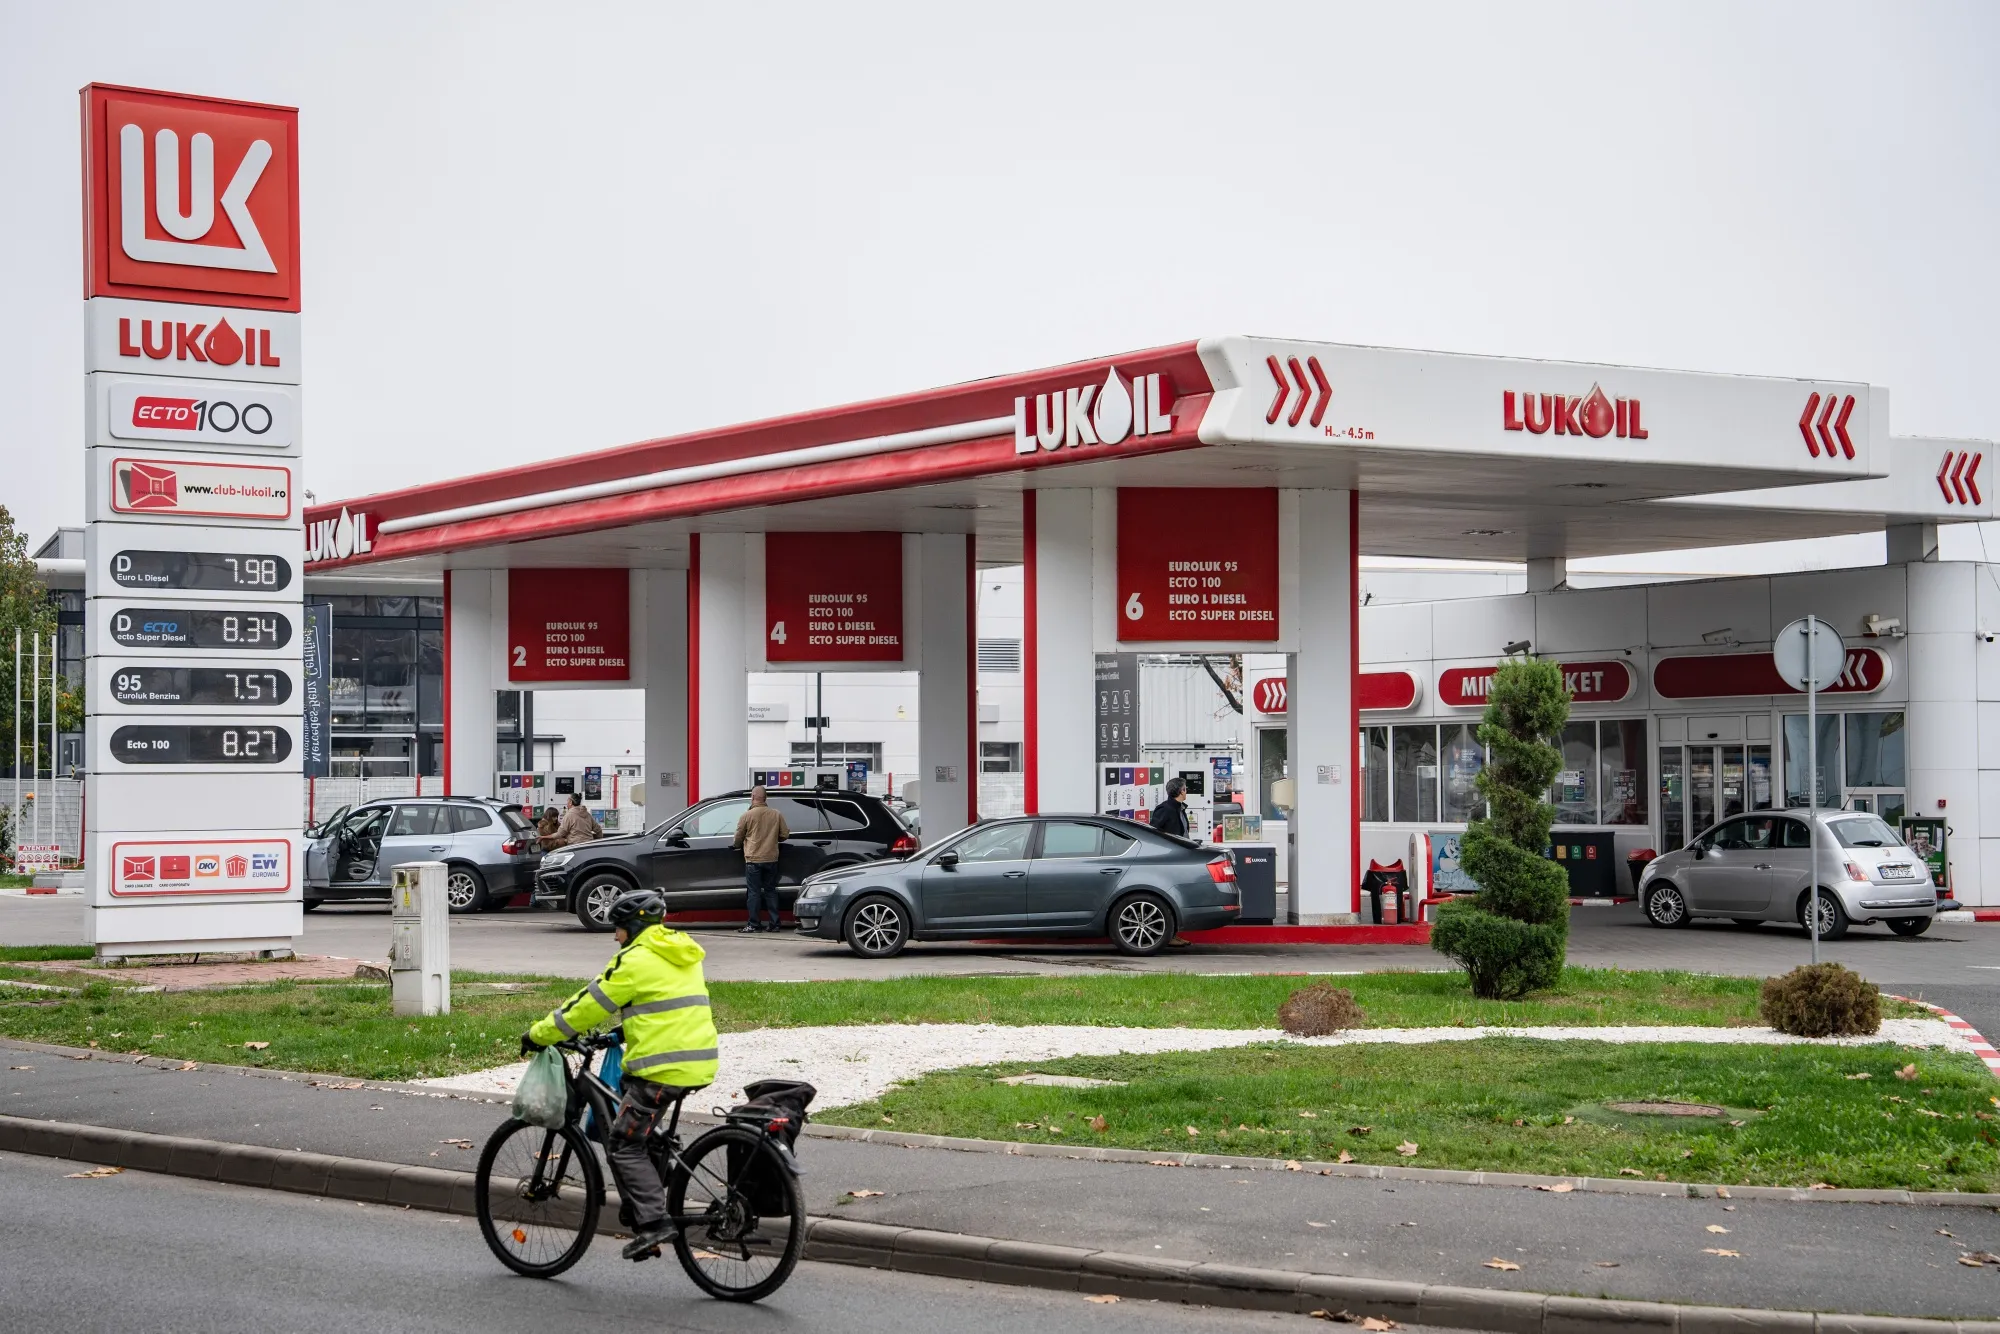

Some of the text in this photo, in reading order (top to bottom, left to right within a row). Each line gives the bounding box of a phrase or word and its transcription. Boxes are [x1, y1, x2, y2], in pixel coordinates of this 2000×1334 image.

[120, 123, 278, 274] LUK
[119, 316, 280, 367] LUKOIL
[1015, 365, 1171, 454] LUKOIL
[1504, 381, 1648, 439] LUKOIL
[138, 400, 273, 435] ECTO 100
[1348, 427, 1363, 439] 4.5
[1365, 431, 1374, 440] m
[184, 484, 286, 498] www.club-lukoil.ro
[116, 555, 276, 585] D 7.98
[1168, 561, 1238, 572] EUROLUK 95
[117, 573, 169, 582] Euro L Diesel
[1169, 577, 1221, 588] ECTO 100
[809, 594, 868, 603] EUROLUK 95
[1169, 594, 1247, 605] EURO L DIESEL
[1125, 592, 1144, 621] 6
[809, 608, 854, 617] ECTO 100
[1169, 610, 1274, 621] ECTO SUPER DIESEL
[116, 614, 277, 642] D 8.34
[143, 622, 178, 633] ECTO
[546, 622, 598, 630] EUROLUK 95
[809, 622, 876, 631] EURO L DIESEL
[136, 633, 160, 643] Super
[161, 633, 186, 642] Diesel
[546, 634, 585, 642] ECTO 100
[770, 621, 787, 645] 4
[809, 636, 899, 645] ECTO SUPER DIESEL
[546, 646, 605, 654] EURO L DIESEL
[513, 645, 527, 667] 2
[546, 658, 625, 667] ECTO SUPER DIESEL
[117, 674, 277, 700] 95 7.57
[1565, 671, 1604, 693] KET
[117, 692, 180, 700] Euroluk Benzina
[127, 730, 277, 757] Ecto 100 8.27
[198, 862, 217, 870] DKV
